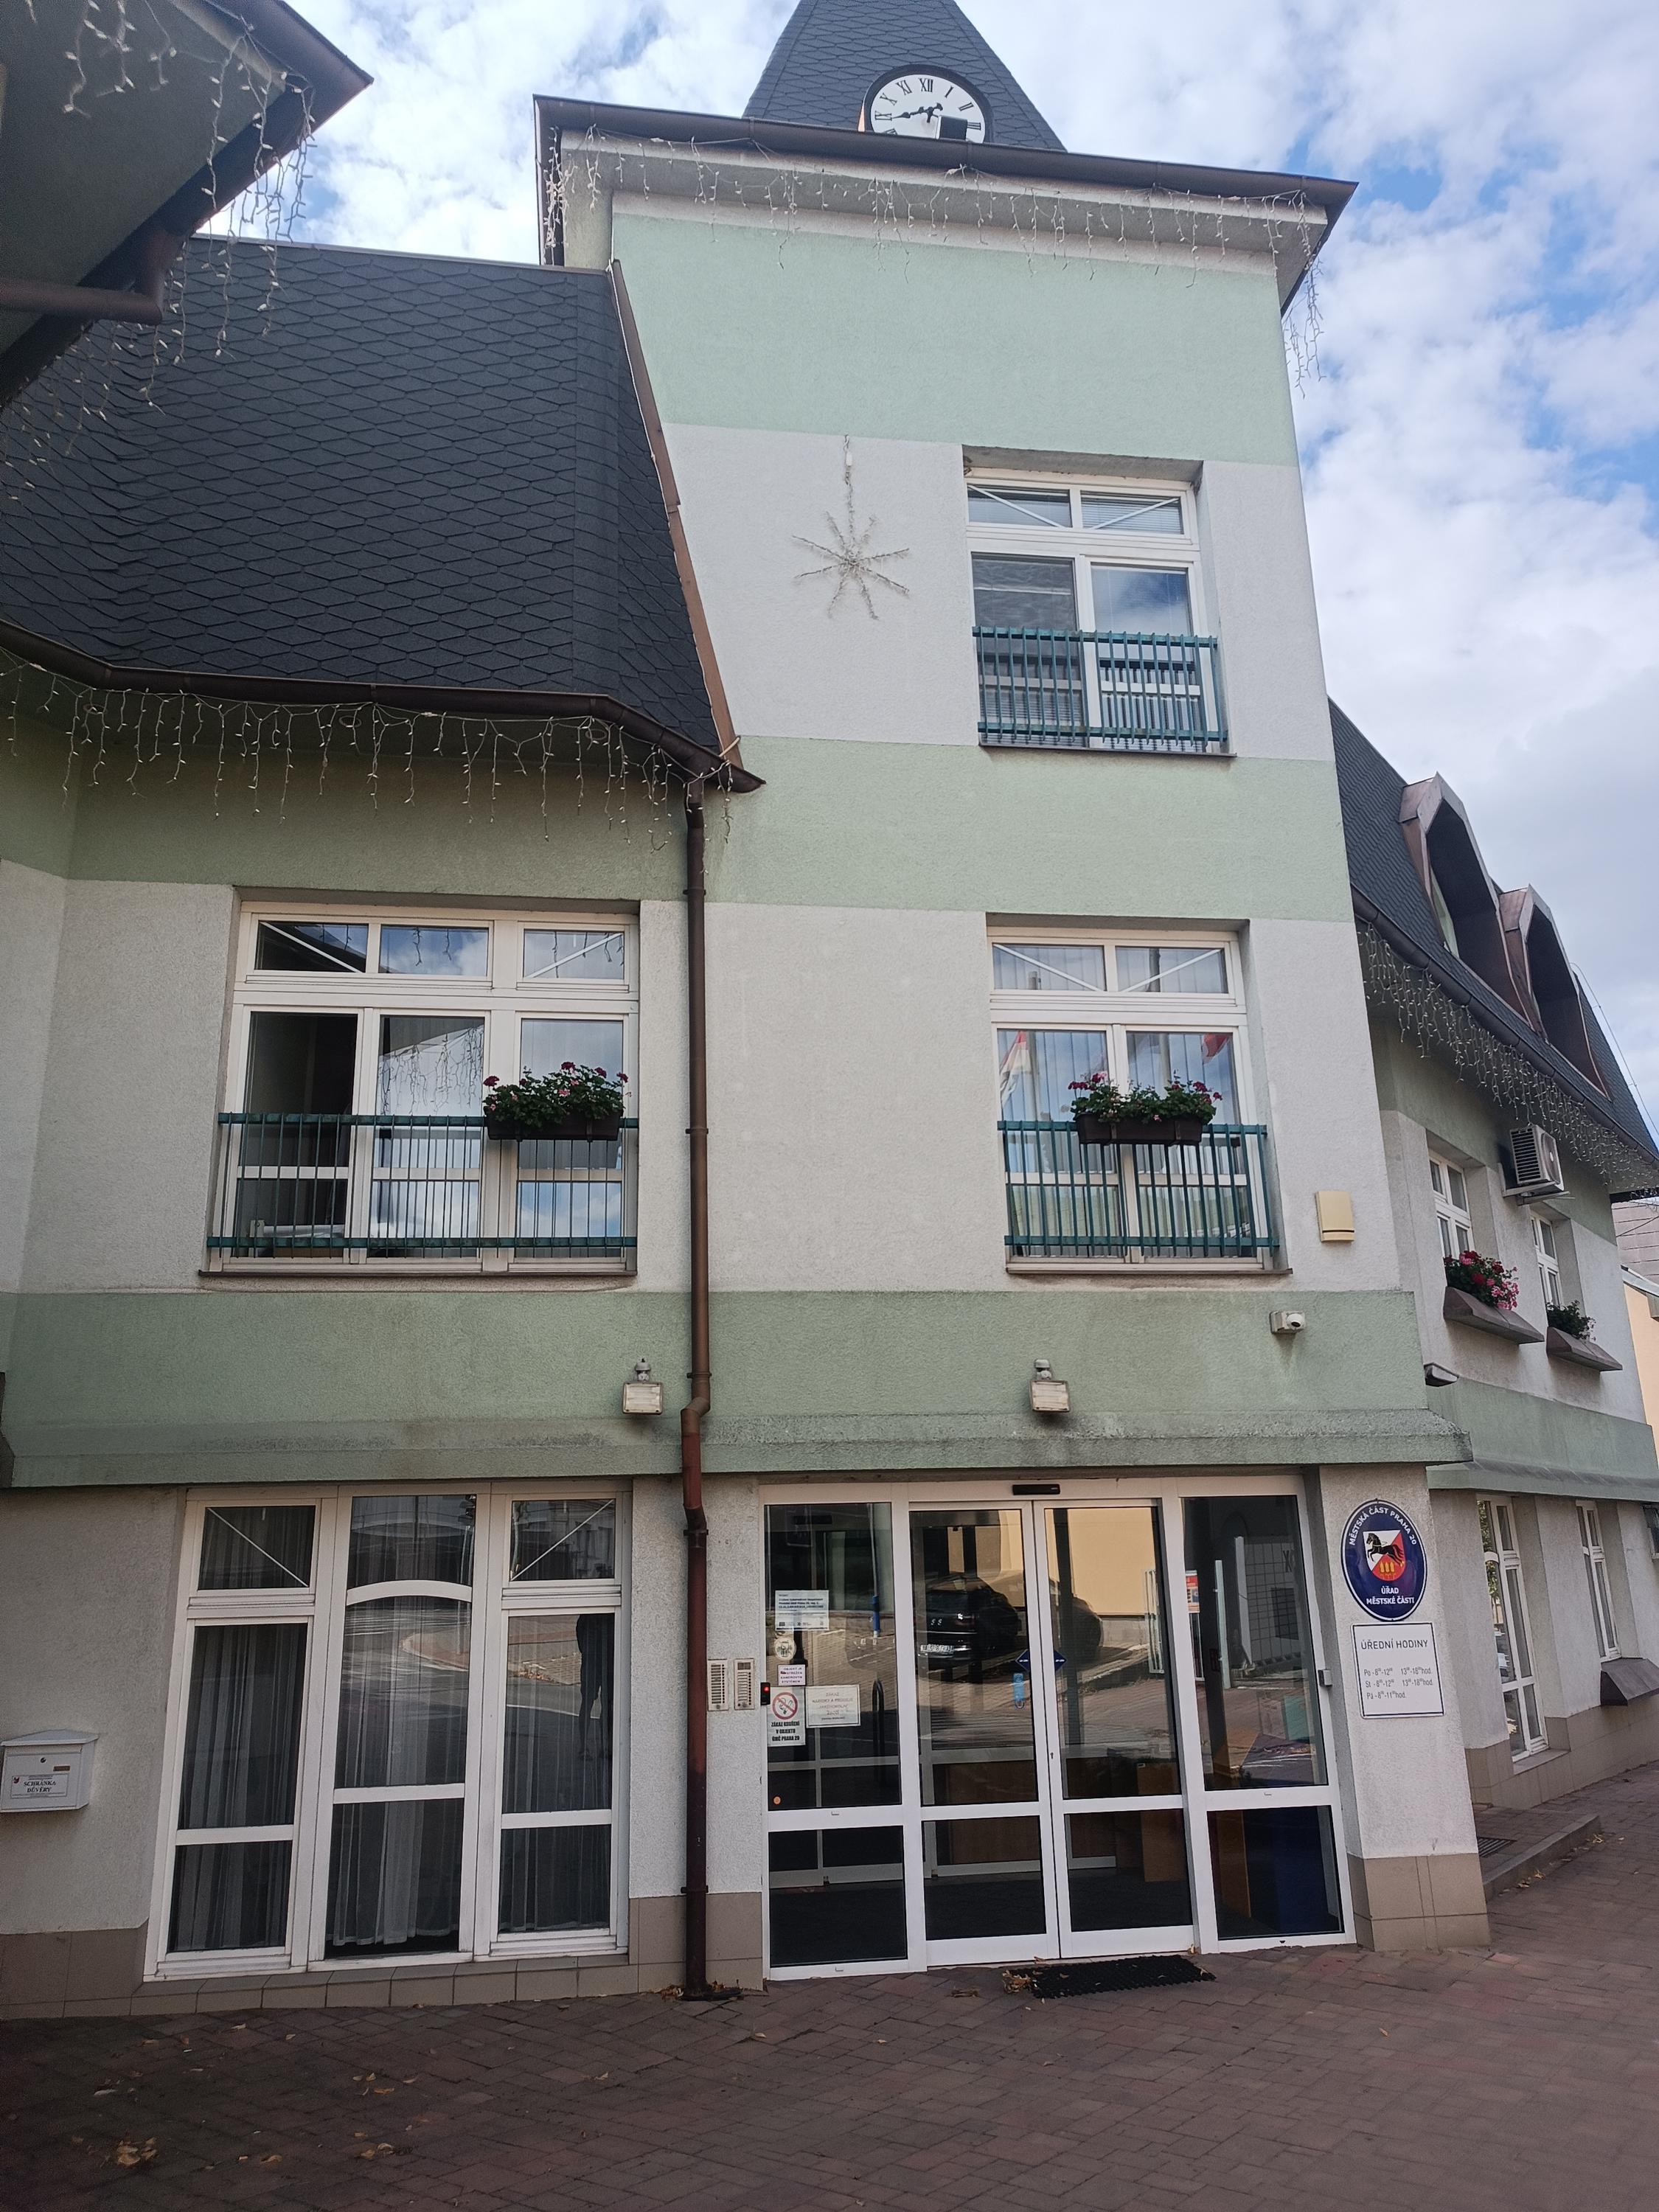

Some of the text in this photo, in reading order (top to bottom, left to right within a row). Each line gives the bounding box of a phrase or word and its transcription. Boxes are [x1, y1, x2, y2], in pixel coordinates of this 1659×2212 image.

[896, 80, 912, 95] XI
[919, 78, 933, 92] XII
[880, 92, 897, 105] X
[1349, 1506, 1416, 1545] MĚSTSKÁ ČÁST PRAHA 20
[1381, 1585, 1399, 1594] ÚŘAD
[1366, 1595, 1414, 1604] MĚSTSKÉ ČÁSTI
[1361, 1638, 1428, 1649] ÚŘEDNÍ HODINY
